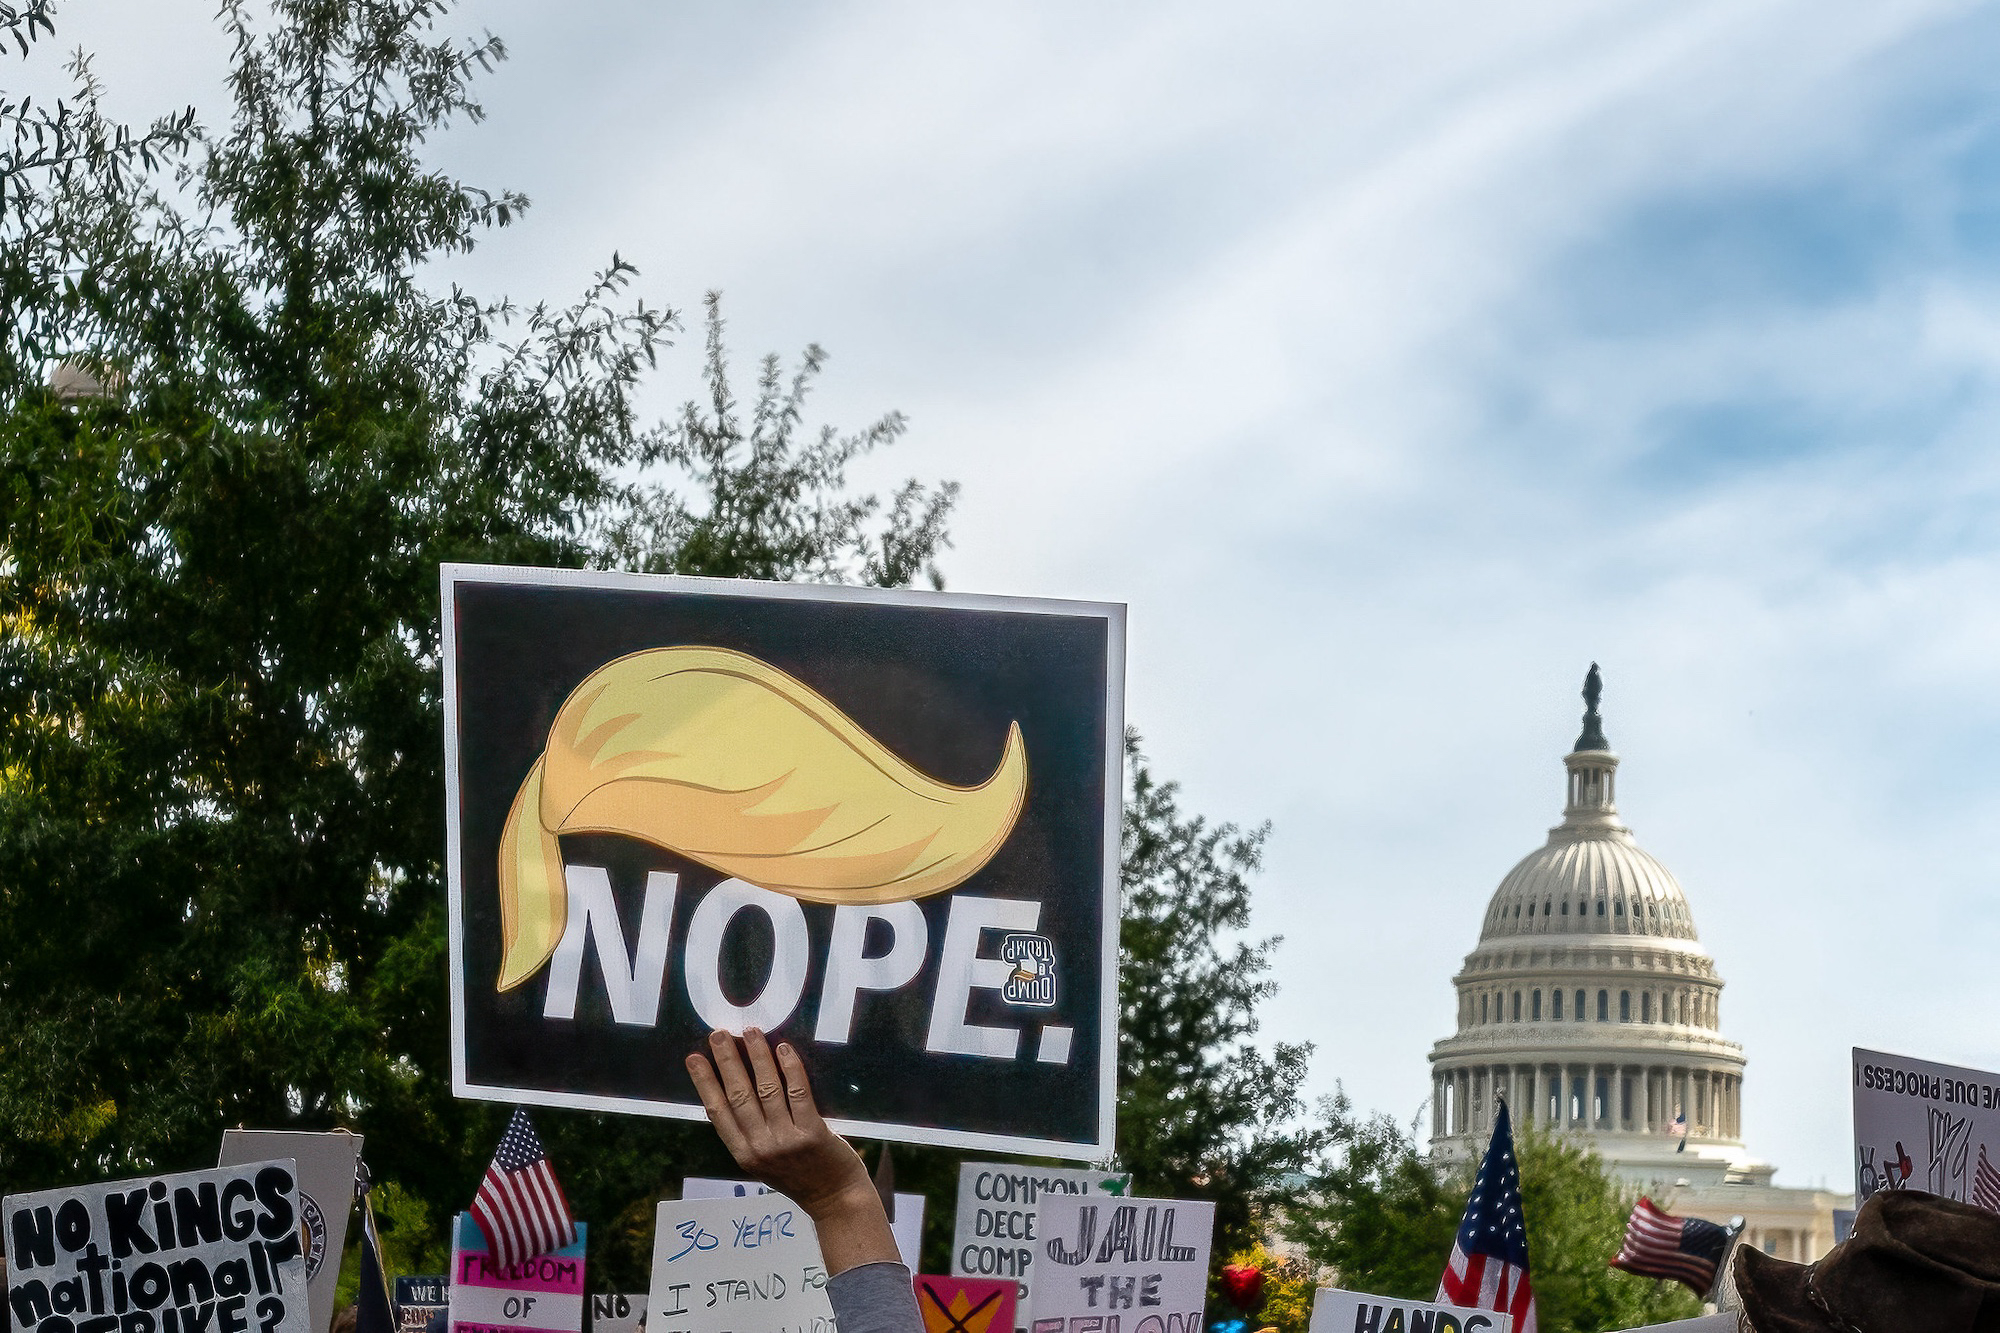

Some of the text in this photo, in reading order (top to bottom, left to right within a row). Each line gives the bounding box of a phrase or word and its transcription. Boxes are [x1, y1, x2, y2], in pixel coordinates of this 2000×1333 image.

[542, 864, 1075, 1066] NOPE.
[1006, 940, 1051, 961] TRUMP
[1007, 977, 1051, 1000] DUMP
[1943, 1078, 1978, 1107] DUE
[12, 1199, 90, 1270] NO
[667, 1210, 795, 1262] 30 YEAR
[1047, 1205, 1196, 1266] JAIL
[960, 1244, 1033, 1277] COMP
[410, 1285, 437, 1302] WE
[503, 1296, 537, 1319] OF
[594, 1294, 631, 1321] NO
[662, 1283, 690, 1317] I
[705, 1272, 786, 1308] STAND
[1080, 1273, 1162, 1309] THE
